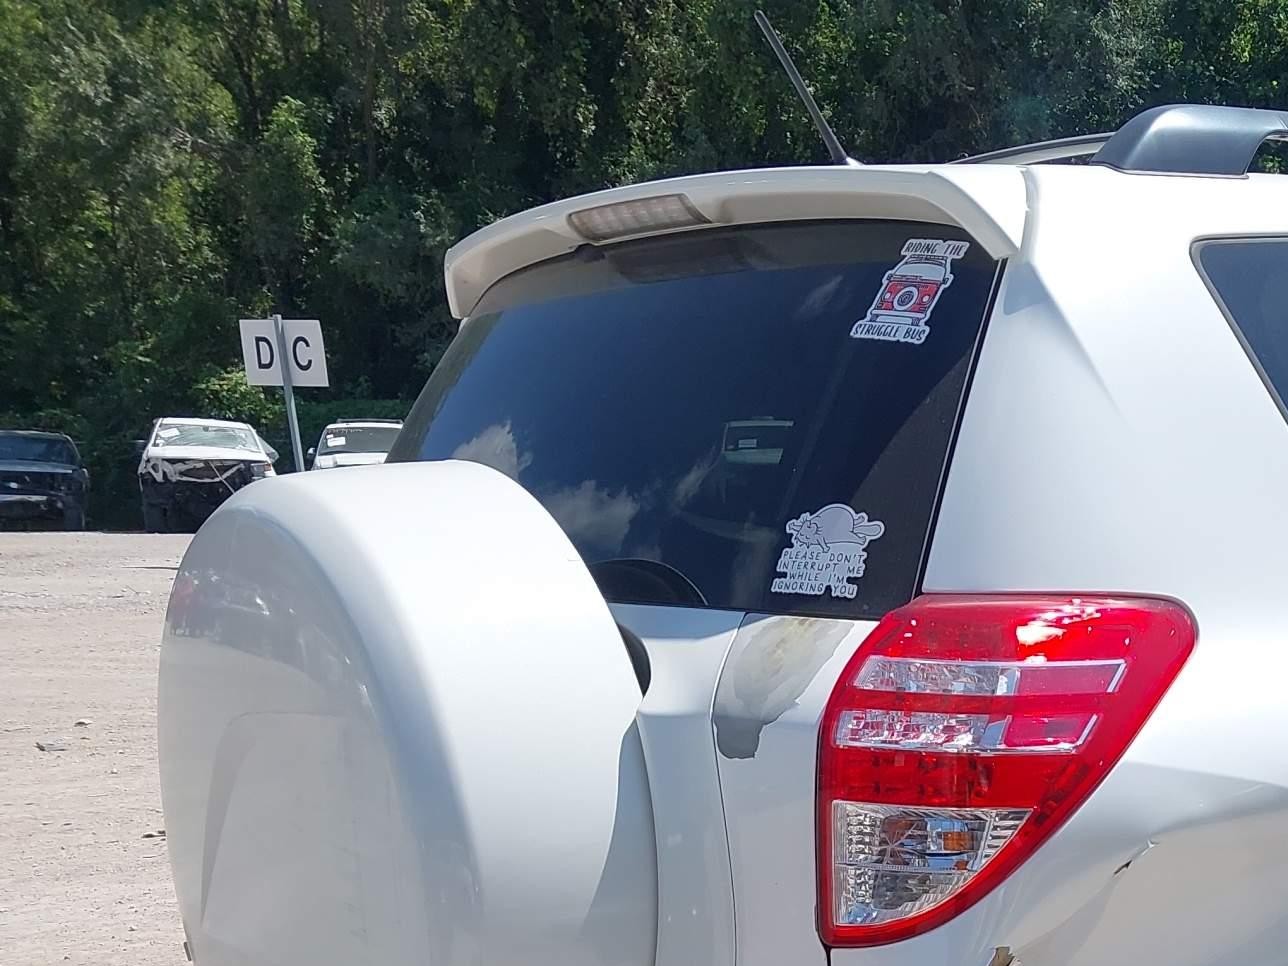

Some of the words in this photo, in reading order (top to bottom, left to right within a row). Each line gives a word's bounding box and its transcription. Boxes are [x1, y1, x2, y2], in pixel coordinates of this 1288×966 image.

[904, 241, 940, 255] RIDING
[943, 243, 968, 257] THE
[853, 323, 901, 338] STRUGGLE
[902, 327, 927, 341] BUS
[254, 336, 275, 370] D
[292, 336, 313, 372] C
[783, 551, 822, 561] PLEASE
[828, 552, 865, 564] DON'T
[778, 560, 840, 572] INTERRUPT
[847, 565, 864, 575] ME
[788, 571, 821, 582] WHILE
[827, 573, 845, 584] I'M
[772, 581, 824, 592] IGNORING
[832, 585, 856, 596] YOU
